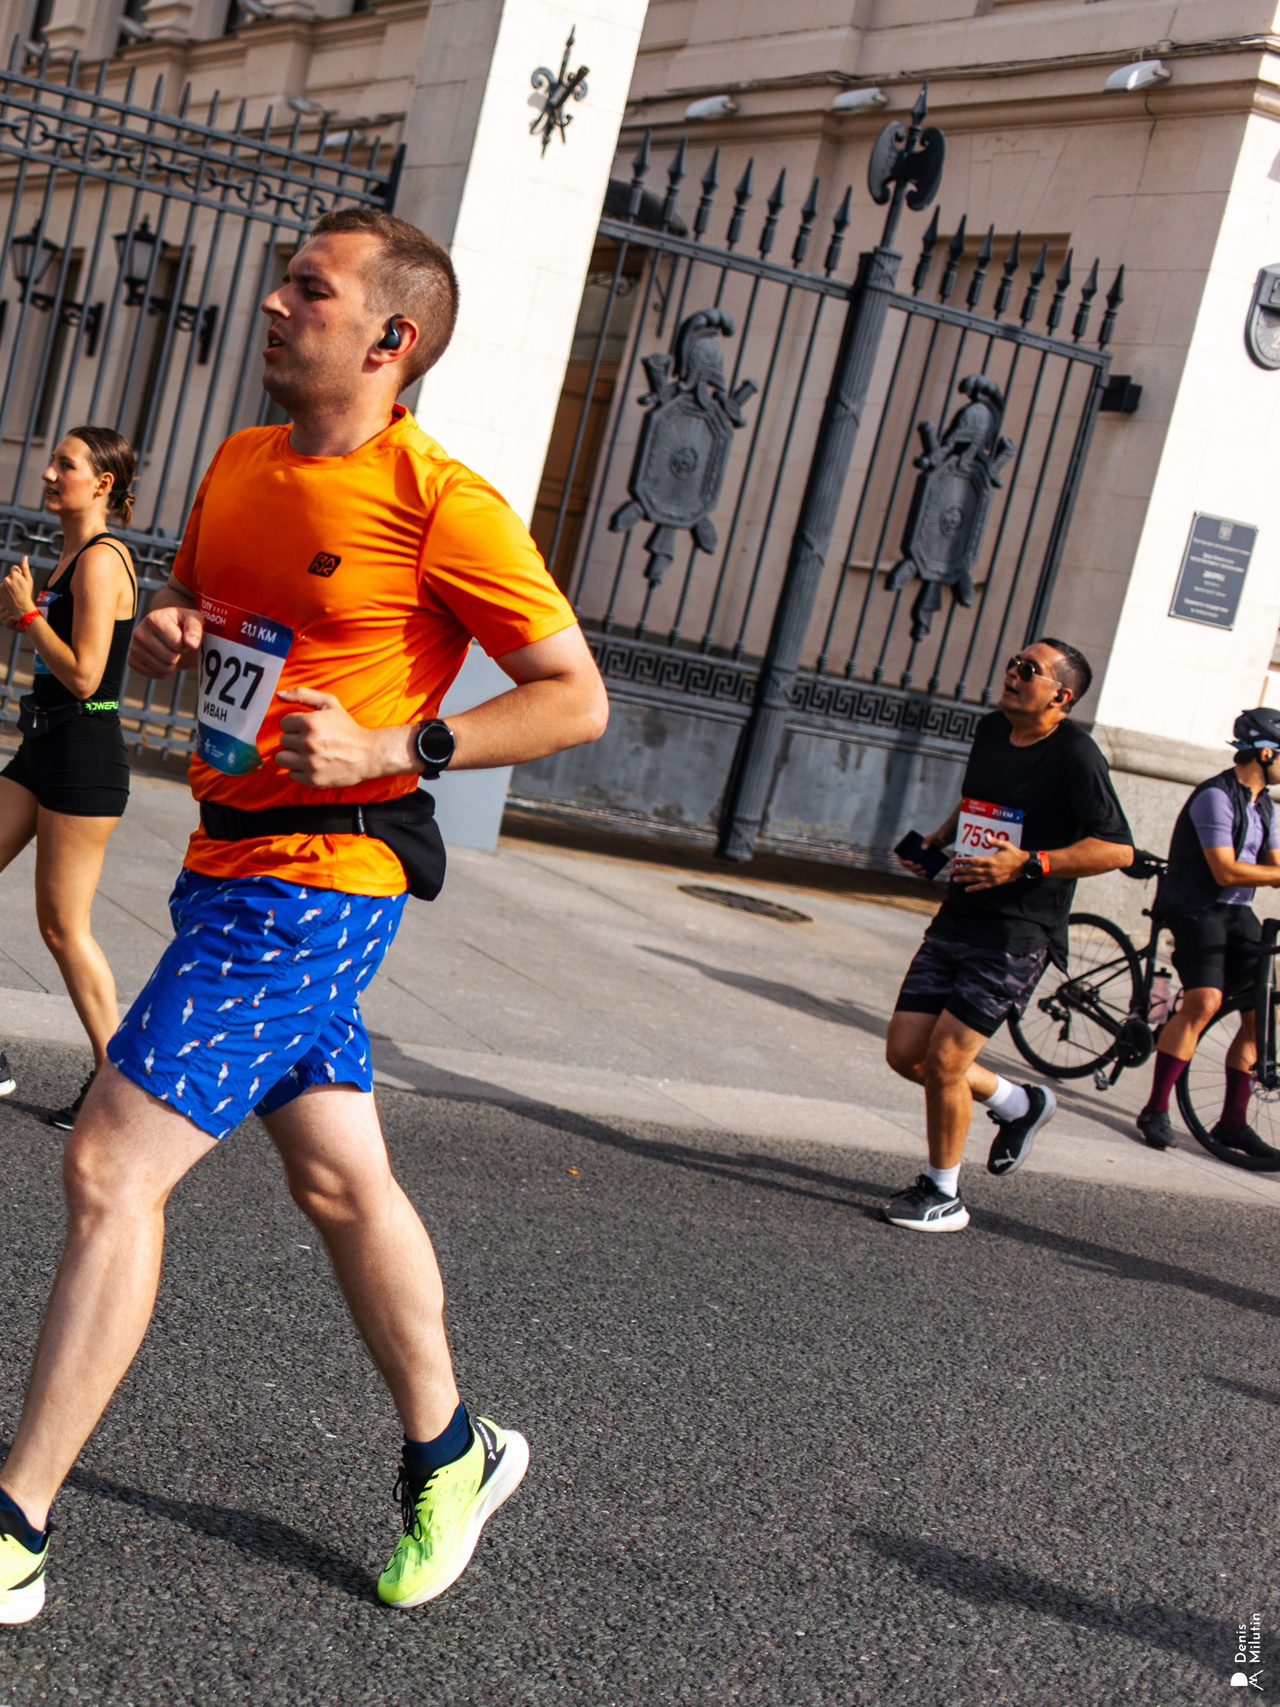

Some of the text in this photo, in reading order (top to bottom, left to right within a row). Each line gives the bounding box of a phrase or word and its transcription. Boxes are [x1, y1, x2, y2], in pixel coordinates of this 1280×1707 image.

[241, 621, 258, 637] 21,1
[199, 642, 265, 711] 927
[203, 701, 228, 722] ИВАН
